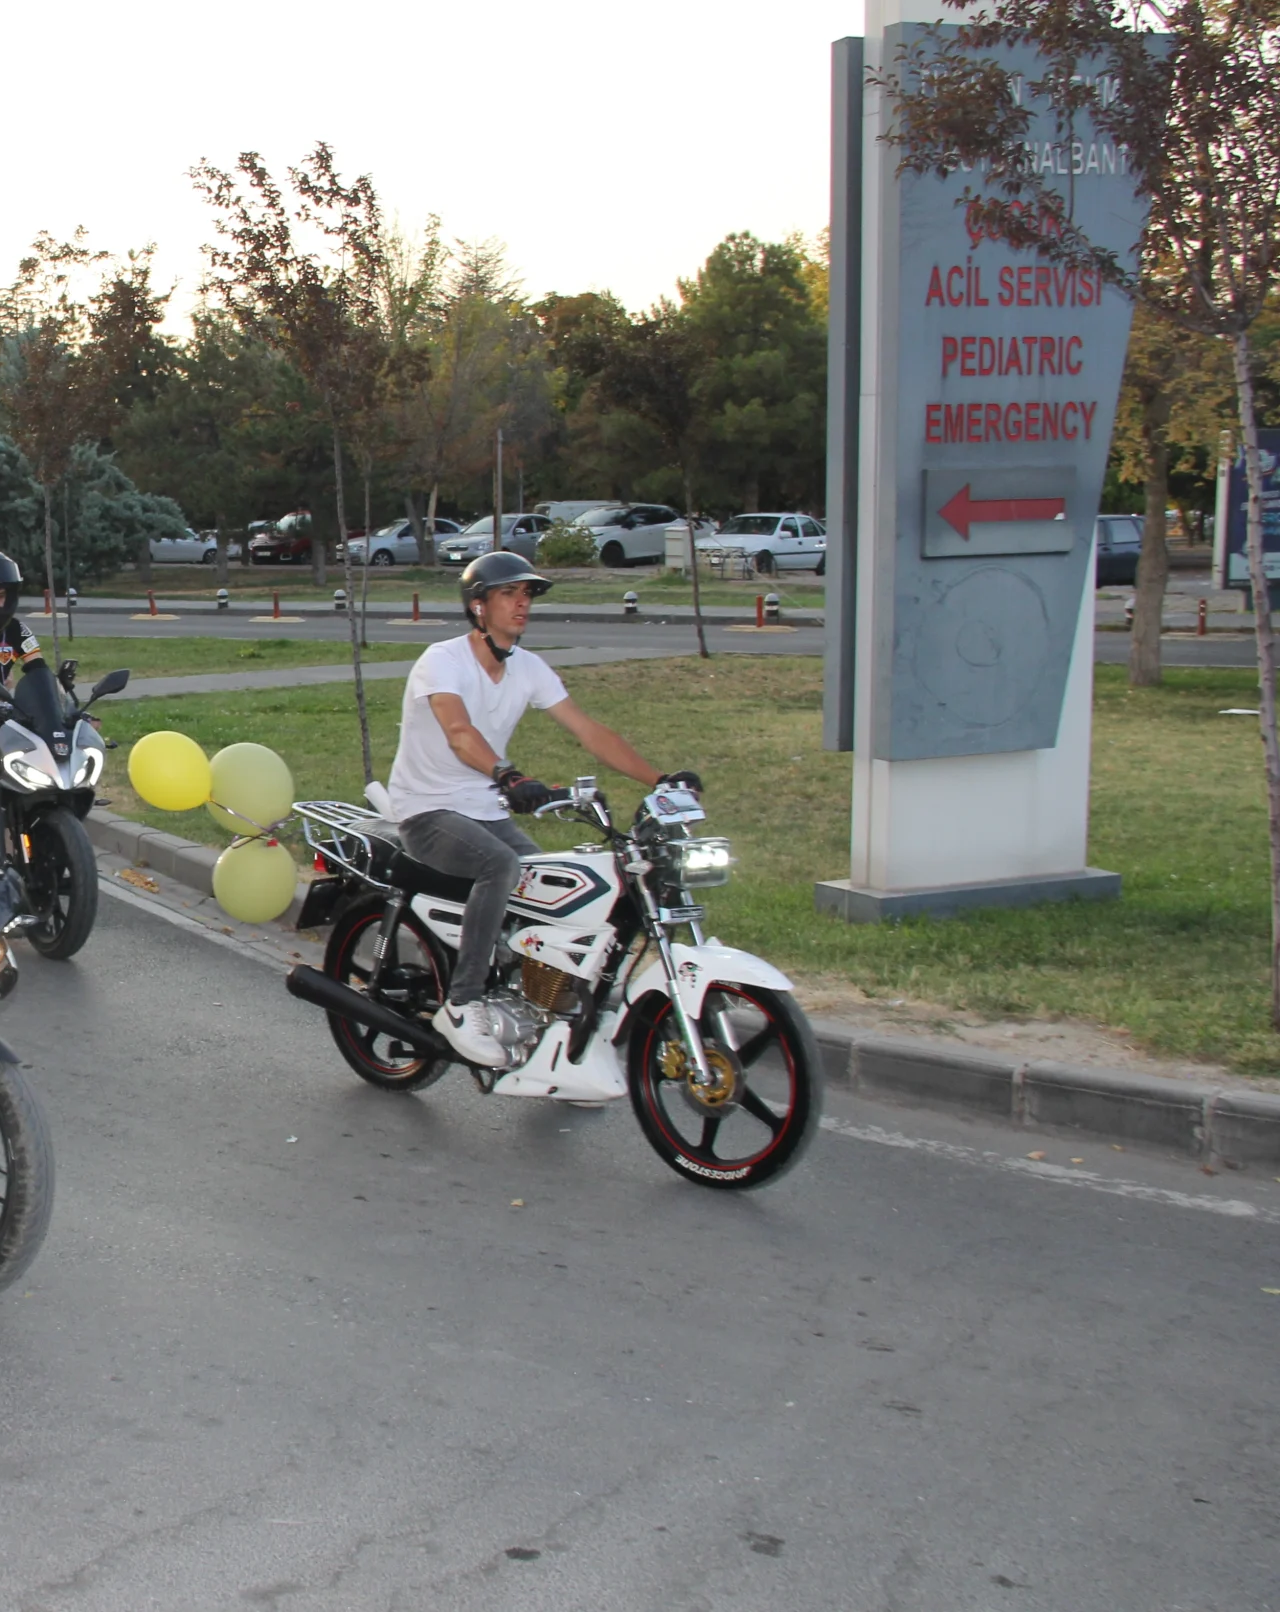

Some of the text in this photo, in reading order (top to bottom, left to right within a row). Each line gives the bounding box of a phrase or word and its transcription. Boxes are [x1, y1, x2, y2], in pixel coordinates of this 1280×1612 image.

[925, 255, 989, 307] ACİL
[941, 335, 1084, 378] PEDIATRIC
[924, 401, 1098, 444] EMERGENCY
